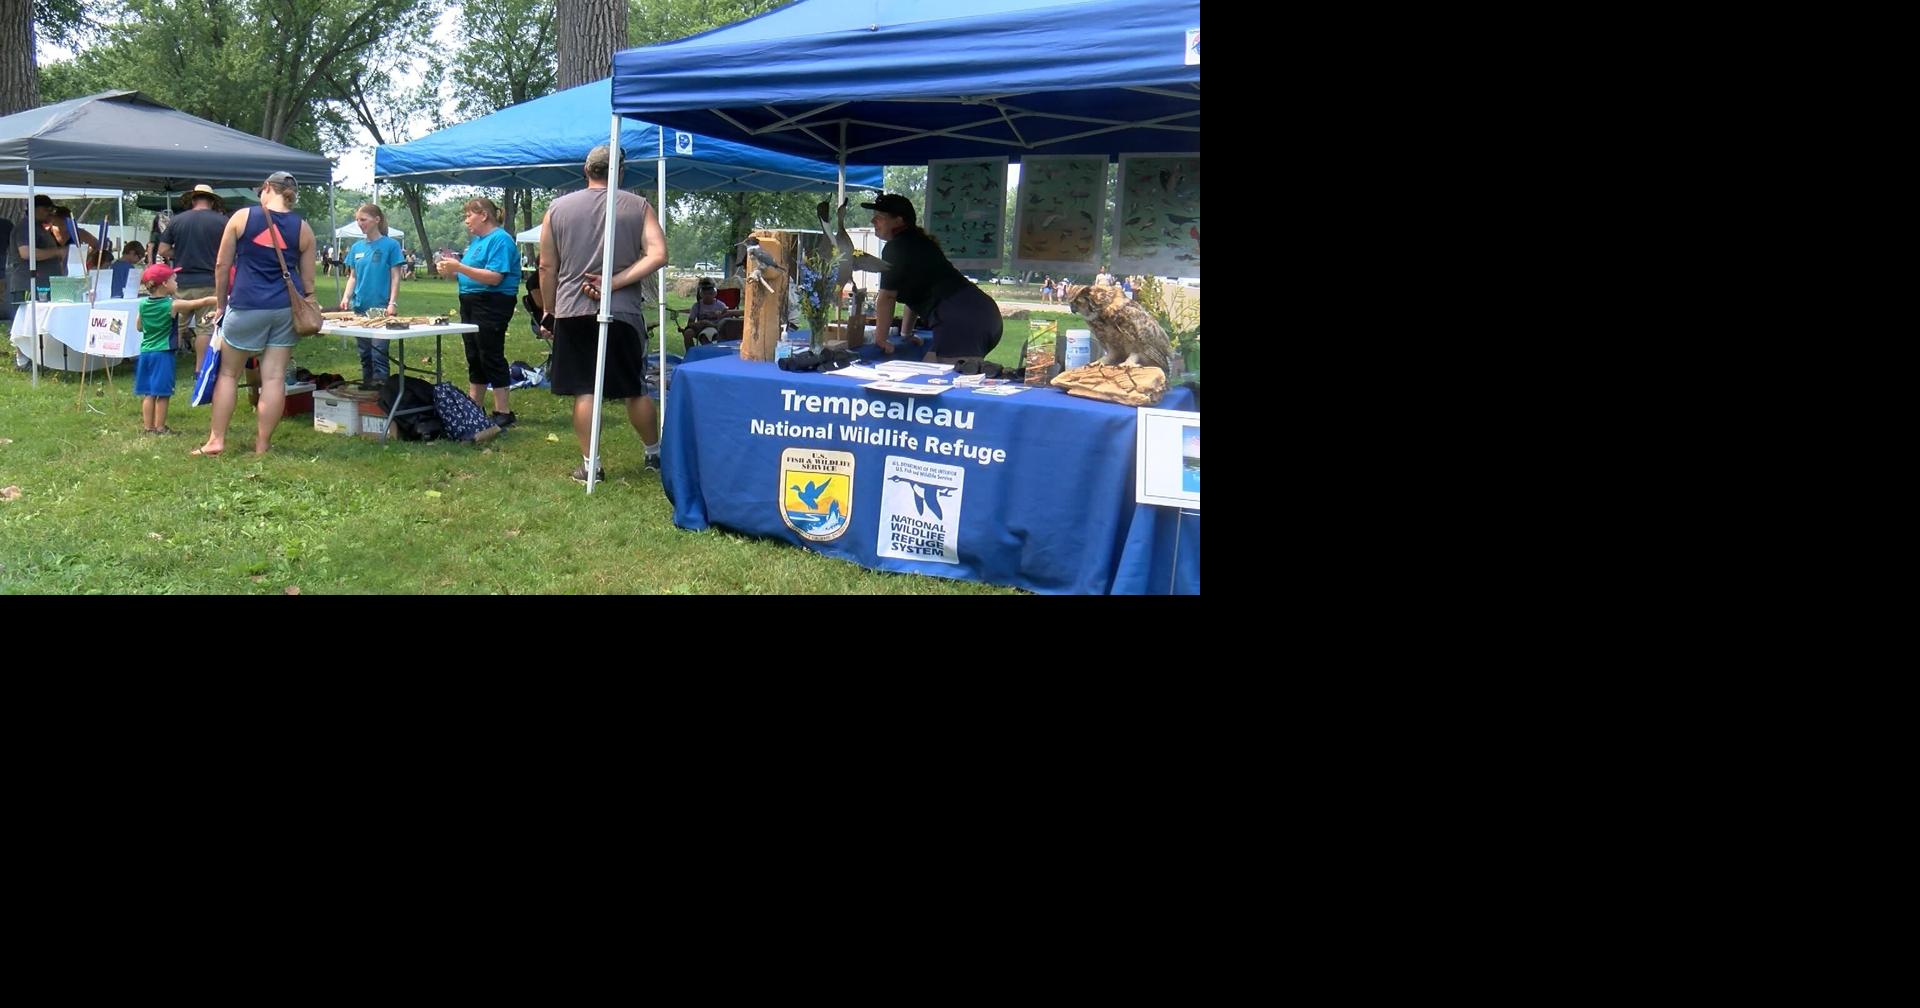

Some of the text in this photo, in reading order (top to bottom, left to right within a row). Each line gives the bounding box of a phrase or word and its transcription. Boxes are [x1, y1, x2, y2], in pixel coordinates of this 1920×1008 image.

[780, 389, 975, 430] Trempealeau
[750, 419, 1006, 465] National Wildlife Refuge
[786, 456, 804, 464] FISH
[801, 463, 837, 471] SERVICE
[891, 514, 946, 533] NATIONAL
[891, 522, 945, 542] WILDLIFE
[891, 532, 944, 550] REFUGE
[891, 542, 944, 557] SYSTEM
